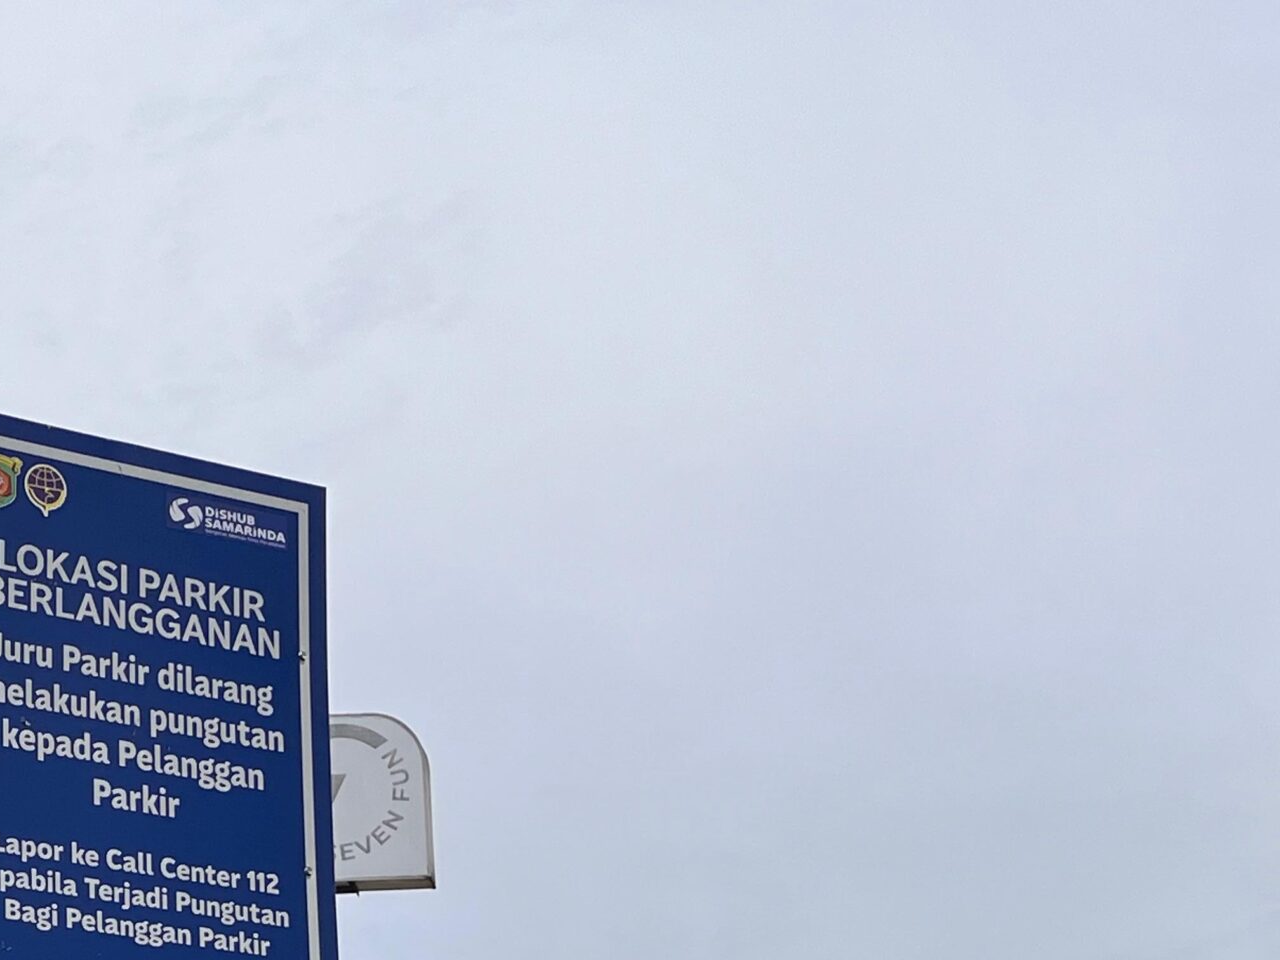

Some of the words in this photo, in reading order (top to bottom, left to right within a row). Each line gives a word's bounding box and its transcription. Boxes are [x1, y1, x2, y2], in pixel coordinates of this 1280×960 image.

[139, 569, 266, 622] PARKIR
[63, 645, 150, 685] Parkir
[157, 663, 274, 716] dilarang
[2, 718, 110, 765] kepada
[118, 741, 266, 792] Pelanggan
[149, 707, 285, 753] pungutan
[93, 778, 180, 819] Parkir
[333, 810, 405, 861] EVEN
[381, 747, 410, 801] FUN
[71, 841, 100, 868] ke
[105, 848, 154, 876] Call
[160, 857, 242, 888] Center
[247, 869, 279, 895] 112
[4, 899, 59, 931] Bagi
[66, 907, 192, 947] Pelanggan
[198, 929, 272, 956] Parkir
[84, 877, 169, 911] Terjadi
[175, 891, 290, 929] Pungutan
